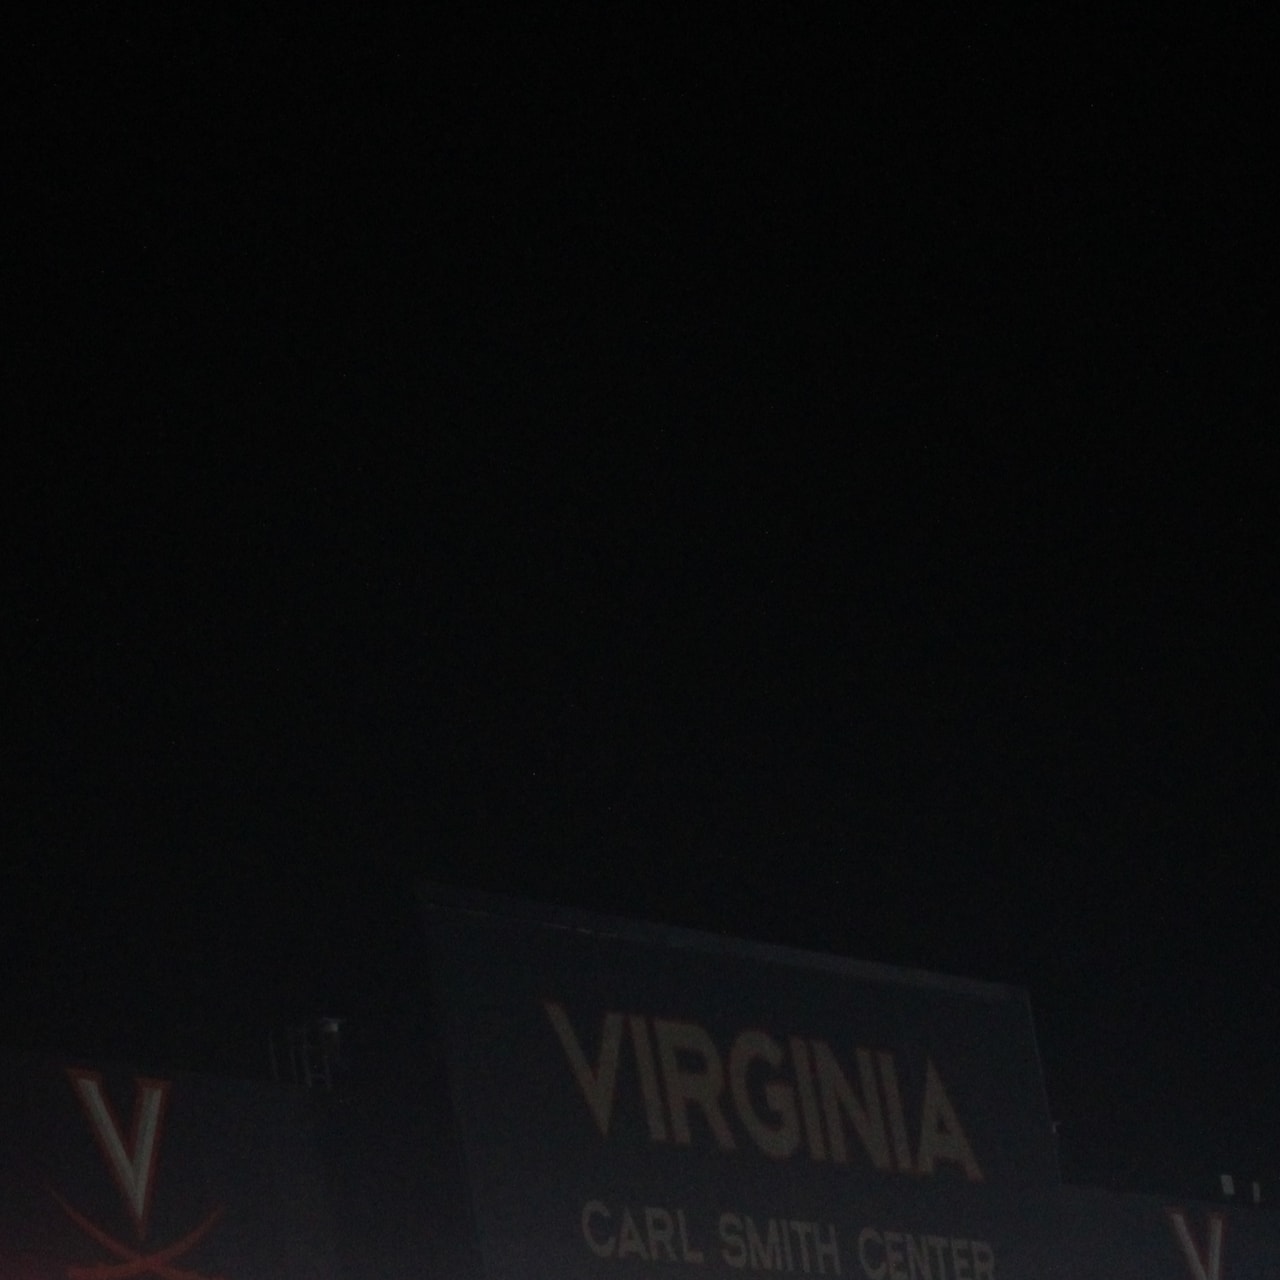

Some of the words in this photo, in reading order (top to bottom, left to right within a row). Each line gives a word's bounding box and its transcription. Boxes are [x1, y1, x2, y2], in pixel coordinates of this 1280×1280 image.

[545, 1001, 984, 1184] VIRGINIA
[582, 1203, 705, 1265] CARL
[720, 1212, 841, 1275] SMITH
